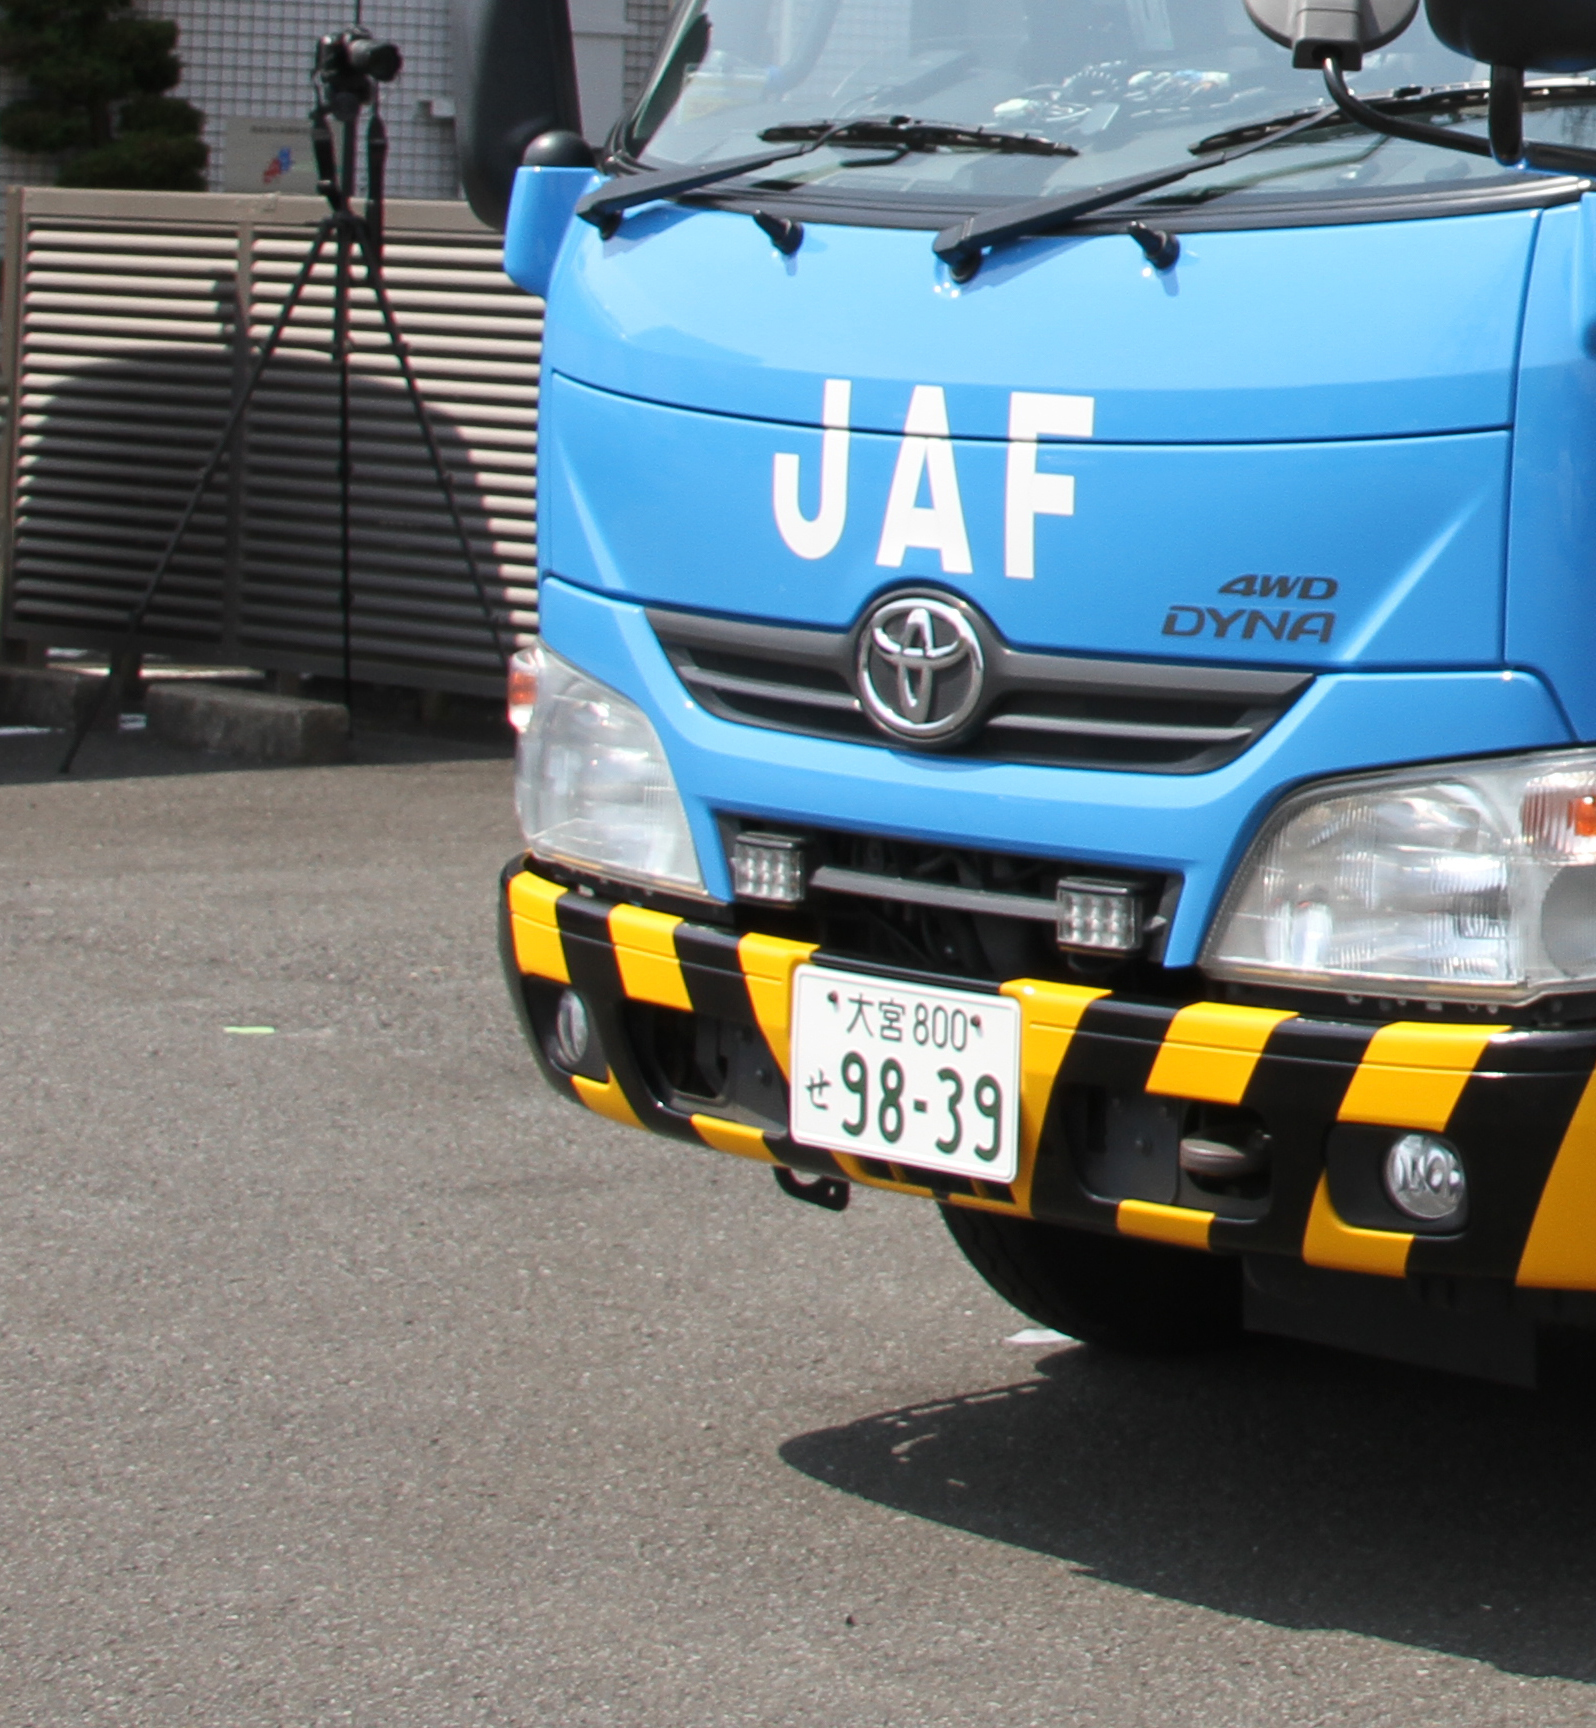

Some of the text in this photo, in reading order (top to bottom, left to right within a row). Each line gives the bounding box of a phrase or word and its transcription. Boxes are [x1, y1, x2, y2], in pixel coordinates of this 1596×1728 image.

[771, 378, 1095, 580] JAF
[1218, 573, 1339, 600] 4WD
[1161, 605, 1337, 644] DYNA
[846, 993, 968, 1053] 大宮 800
[805, 1050, 1003, 1163] せ 98-39
